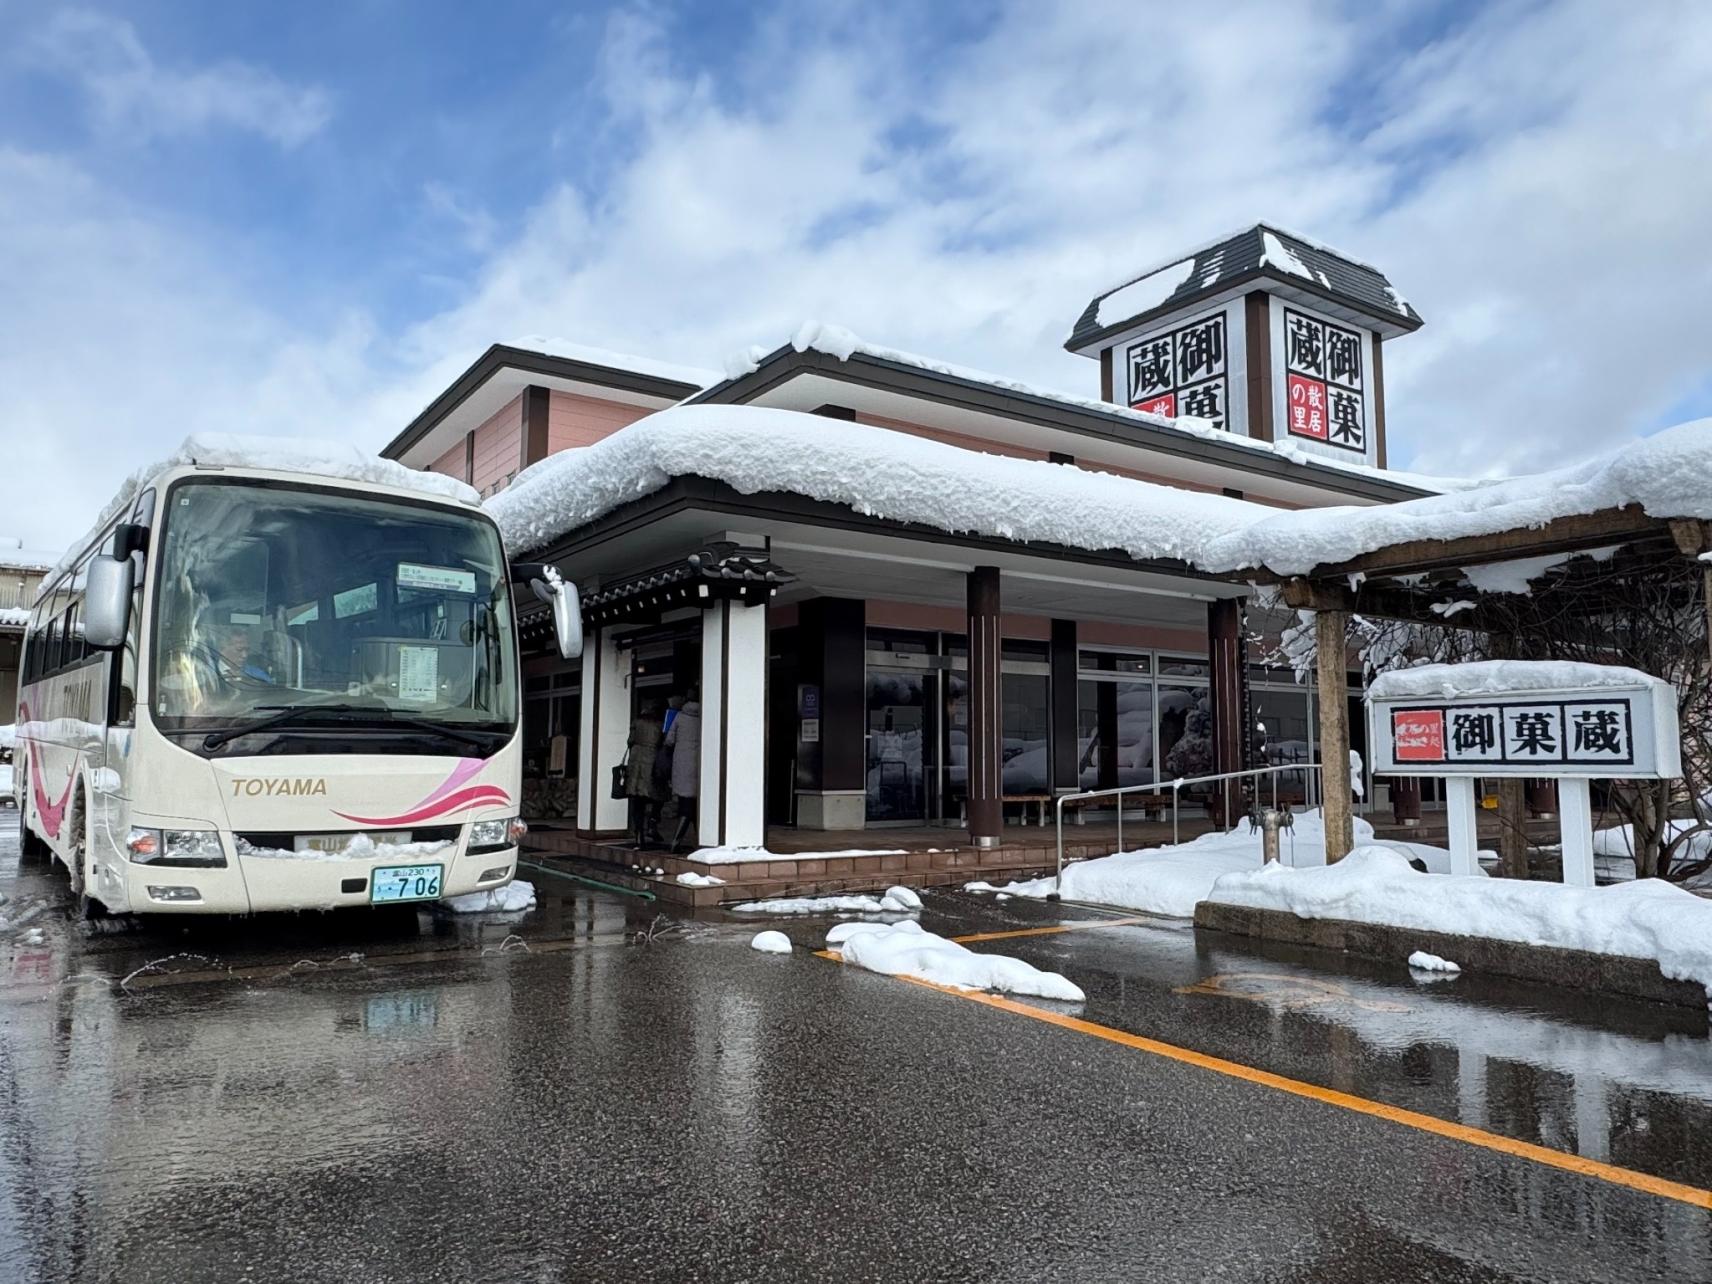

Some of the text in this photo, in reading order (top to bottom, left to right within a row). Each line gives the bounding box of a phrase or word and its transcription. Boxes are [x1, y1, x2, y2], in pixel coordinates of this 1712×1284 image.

[1452, 710, 1622, 755] 御菓蔵
[232, 778, 327, 797] TOYAMA
